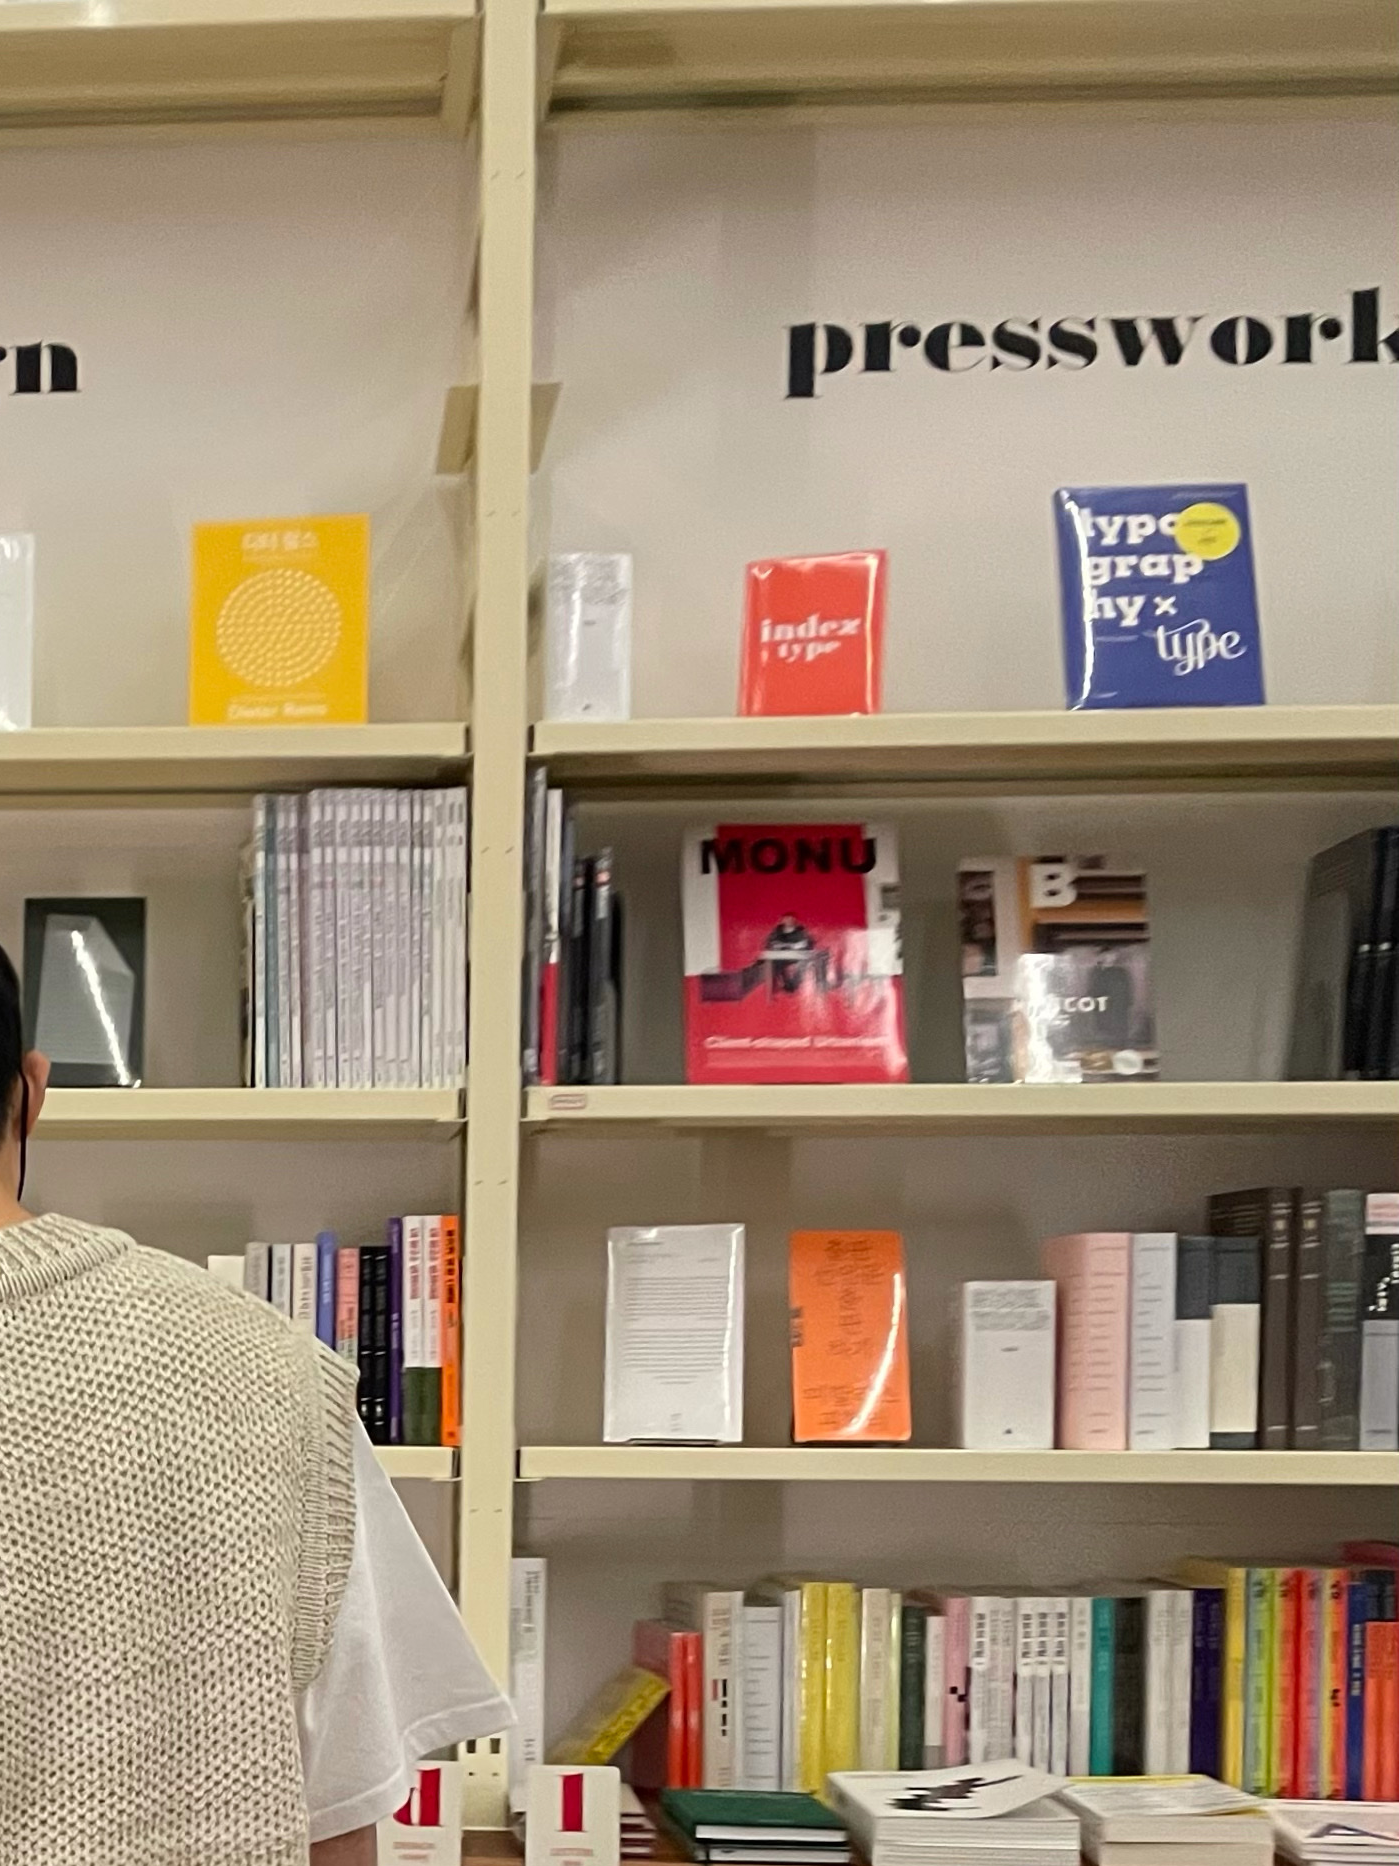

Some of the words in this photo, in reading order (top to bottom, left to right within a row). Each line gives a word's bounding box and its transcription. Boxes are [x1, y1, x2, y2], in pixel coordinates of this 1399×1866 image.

[783, 286, 1399, 400] presswork
[761, 612, 861, 642] index
[1156, 618, 1247, 677] type
[701, 837, 877, 875] MONU
